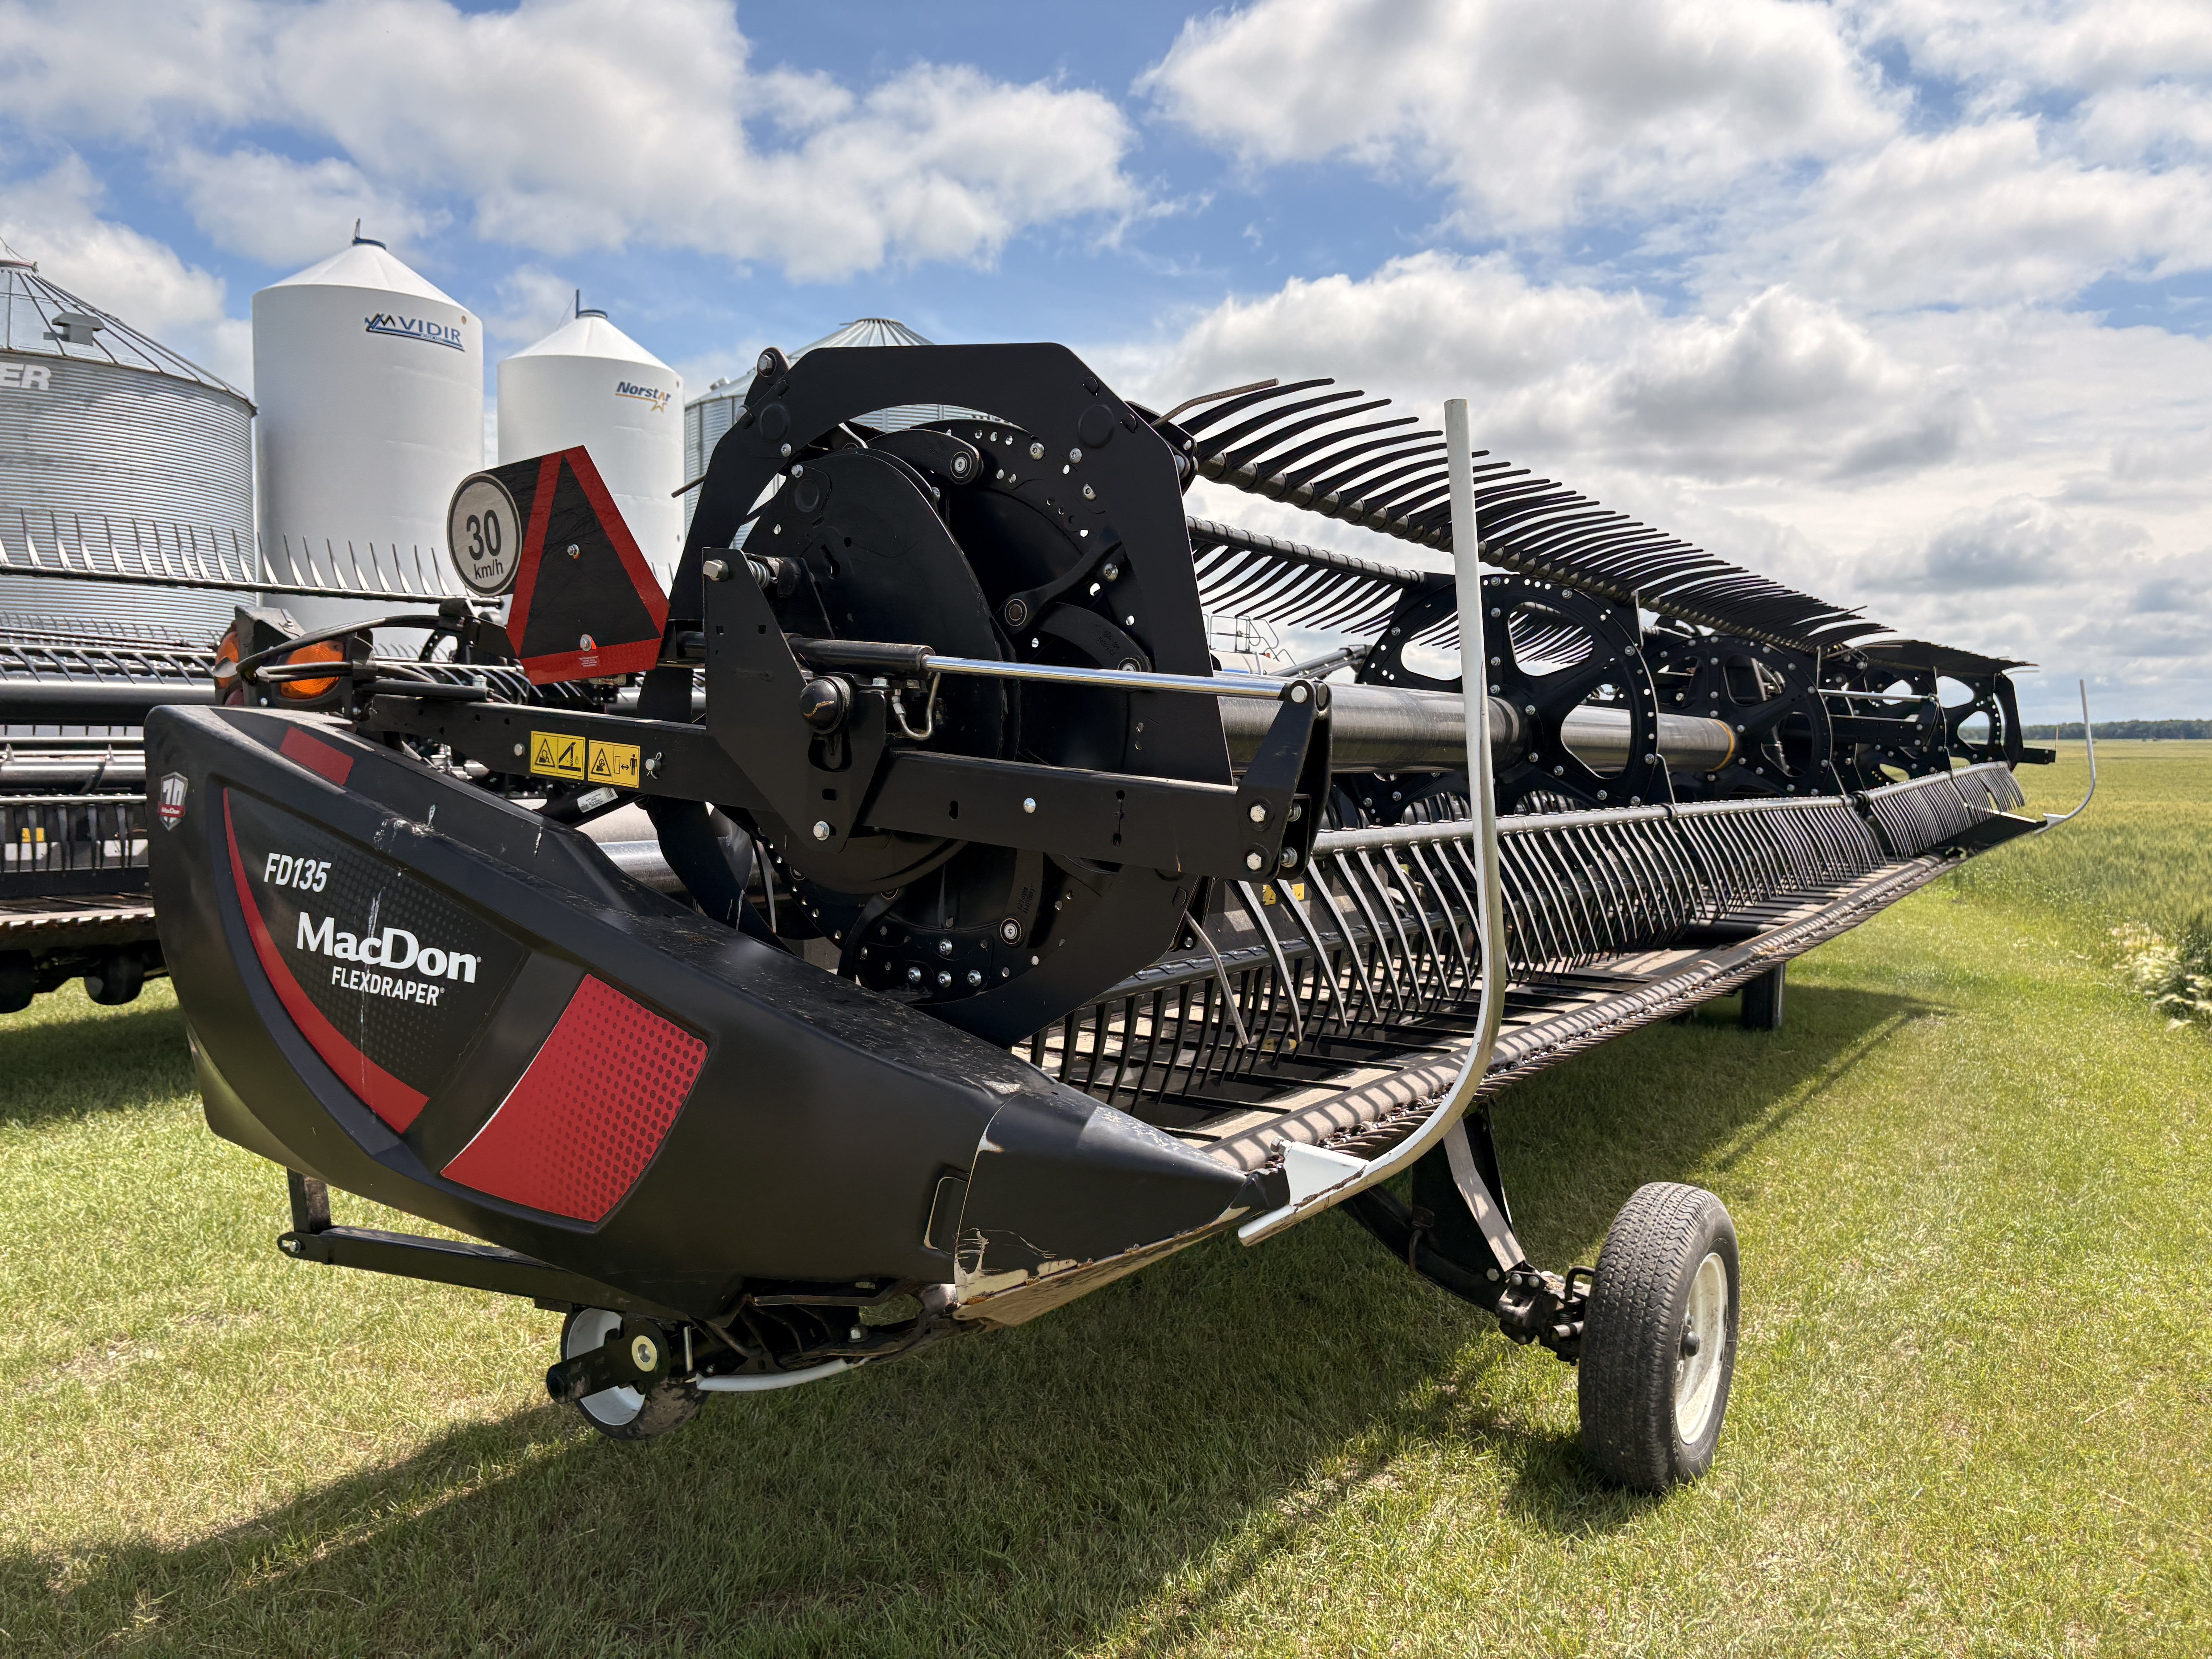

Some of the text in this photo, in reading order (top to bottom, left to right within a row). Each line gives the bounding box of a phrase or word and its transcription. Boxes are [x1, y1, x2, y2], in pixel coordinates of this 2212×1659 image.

[397, 316, 460, 342] VIDIR
[466, 509, 501, 561] 30
[474, 558, 503, 580] km/h
[264, 852, 332, 893] FD135
[297, 911, 477, 984] MacDon
